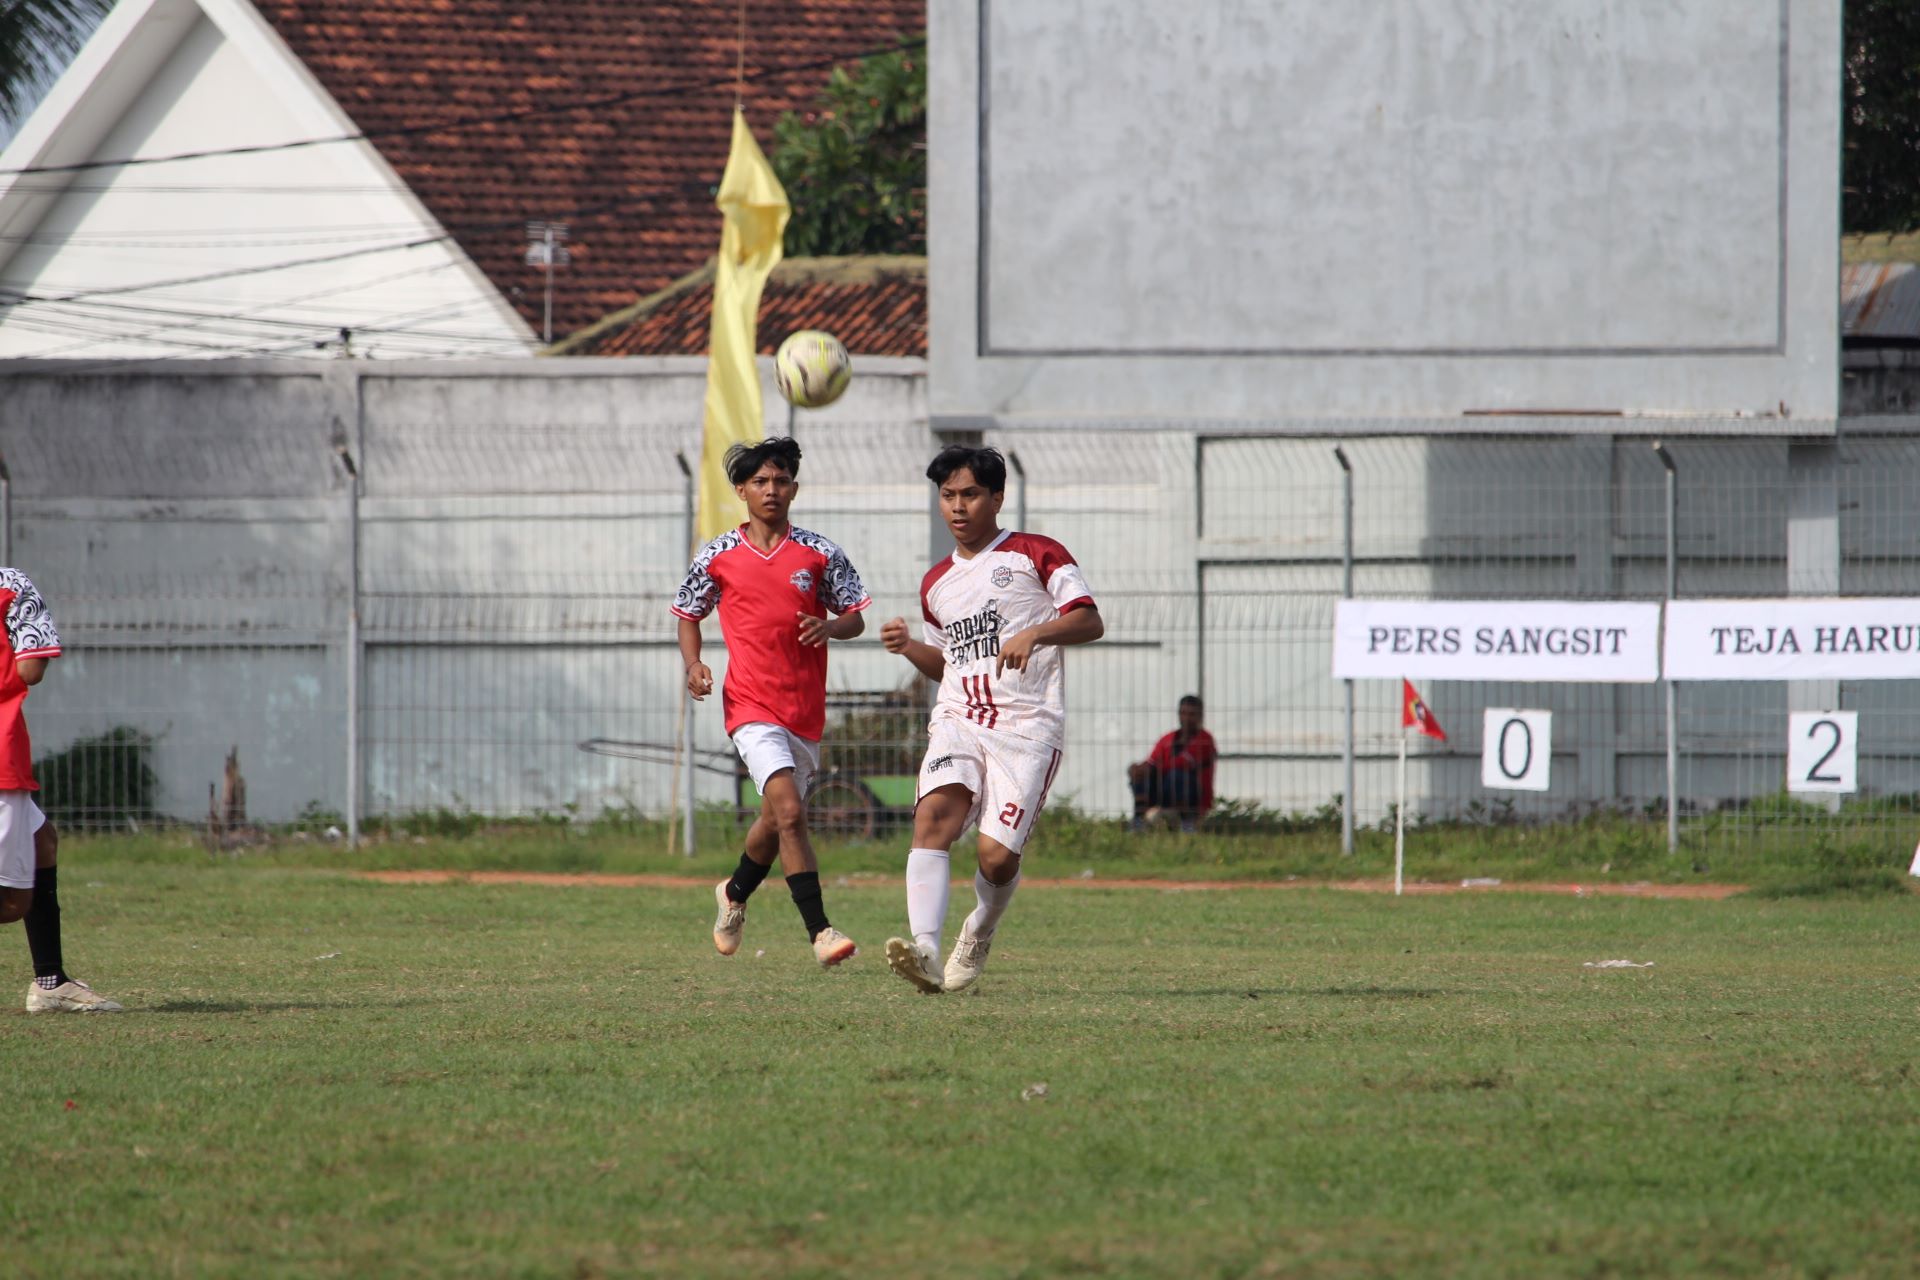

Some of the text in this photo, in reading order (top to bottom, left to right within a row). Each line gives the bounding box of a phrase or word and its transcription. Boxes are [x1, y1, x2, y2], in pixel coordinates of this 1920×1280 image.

[1367, 626, 1627, 655] PERS SANGSIT
[1710, 624, 1920, 655] TEJA HARU
[1499, 718, 1531, 780] 0
[1806, 720, 1842, 782] 2
[999, 802, 1025, 831] 21
